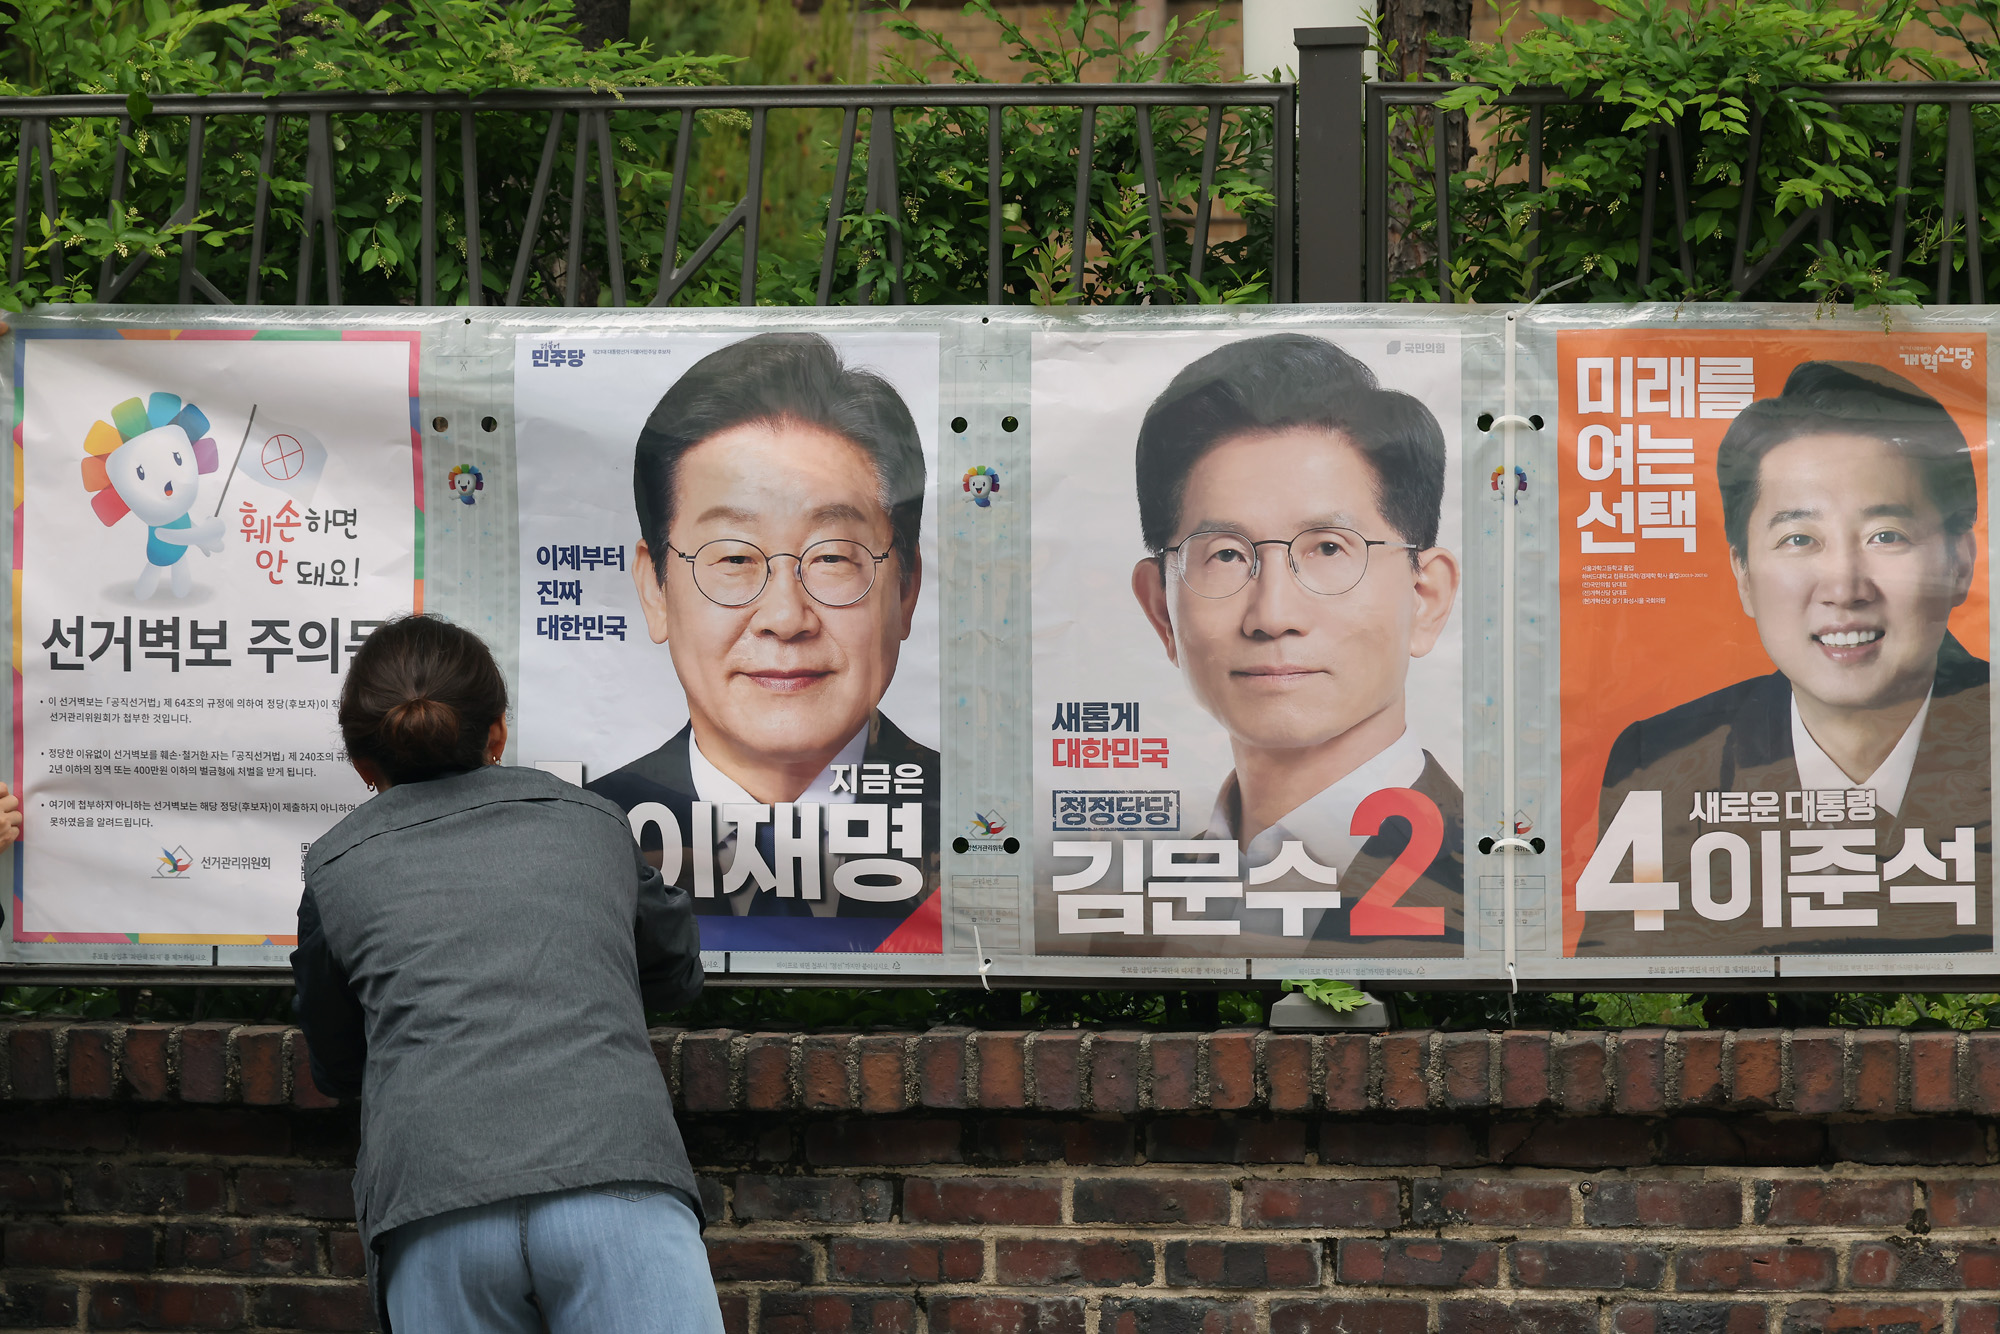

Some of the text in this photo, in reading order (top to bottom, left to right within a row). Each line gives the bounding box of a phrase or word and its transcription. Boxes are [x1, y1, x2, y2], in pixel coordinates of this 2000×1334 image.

[532, 349, 586, 367] 민주당
[1404, 341, 1446, 354] 국민의힘
[1899, 345, 1975, 373] 개혁신당
[1577, 356, 1756, 420] 미래를
[1577, 423, 1695, 486] 여는
[239, 499, 358, 545] 훼손하면
[1577, 490, 1697, 554] 선택
[256, 549, 361, 588] 안 돼요!
[536, 544, 625, 572] 이제부터
[536, 579, 583, 606] 진짜
[536, 614, 627, 642] 대한민국
[42, 615, 232, 673] 선거벽보
[48, 696, 56, 707] 이
[59, 697, 104, 707] 선거벽보는
[163, 698, 172, 708] 제
[174, 698, 204, 708] 64조의
[207, 698, 234, 709] 규정에
[237, 699, 264, 709] 의하여
[267, 699, 329, 710] 정당(후보자)이
[50, 712, 192, 724] 선거관리위원회가 첩부한 것입니다.
[1052, 701, 1140, 734] 새롭게
[48, 748, 74, 759] 정당한
[76, 749, 111, 760] 이유없이
[113, 749, 158, 760] 선거벽보를
[210, 751, 229, 761] 자는
[288, 751, 297, 761] 제
[299, 751, 334, 762] 240조의
[1052, 737, 1170, 769] 대한민국
[49, 764, 317, 778] 2년 이하의 징역 또는 400만원 이하의 벌금형에 처벌을 받게 됩니다.
[829, 763, 925, 796] 지금은
[48, 800, 356, 813] 여기에 첩부하지 아니하는 선거벽보는 해당 정당(후보자)이 제출하지 아니하여
[1059, 795, 1173, 826] 정정당당
[1689, 789, 1877, 823] 새로운 대통령
[50, 817, 154, 828] 못하였음을 알려드립니다.
[200, 854, 271, 871] 선거관리위원회
[626, 800, 924, 903] 이재명
[1052, 786, 1445, 937] 김문수 2
[1575, 790, 1977, 932] 4 이준석
